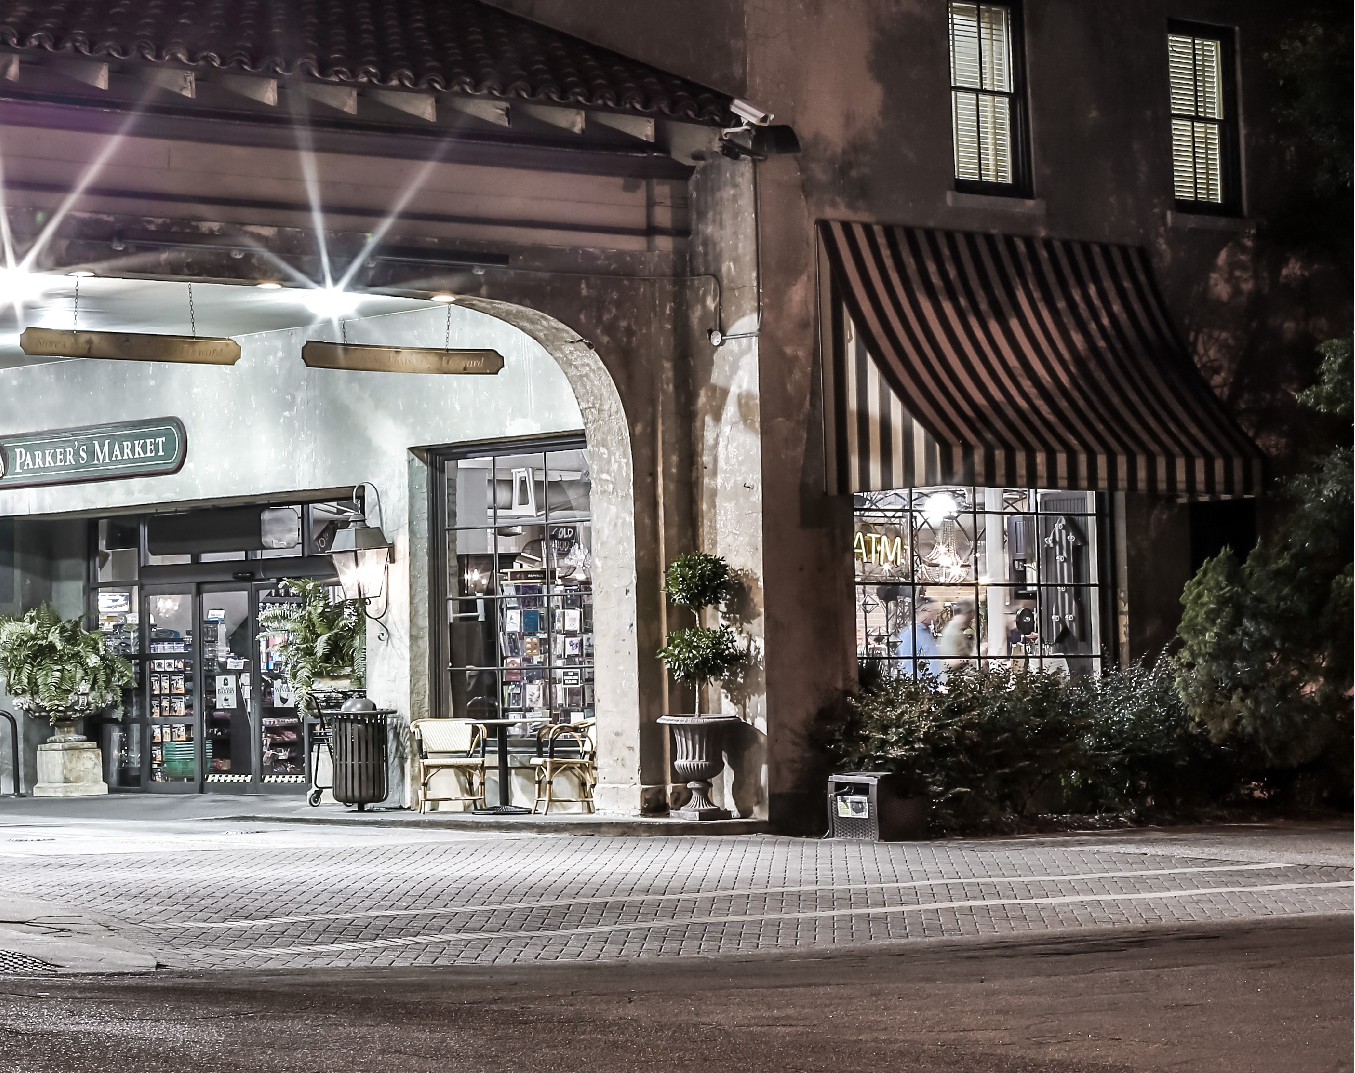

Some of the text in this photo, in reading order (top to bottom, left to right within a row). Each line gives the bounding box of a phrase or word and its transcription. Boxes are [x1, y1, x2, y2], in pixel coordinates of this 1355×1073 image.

[14, 436, 166, 473] PARKER'S MARKET
[853, 531, 902, 566] ATM
